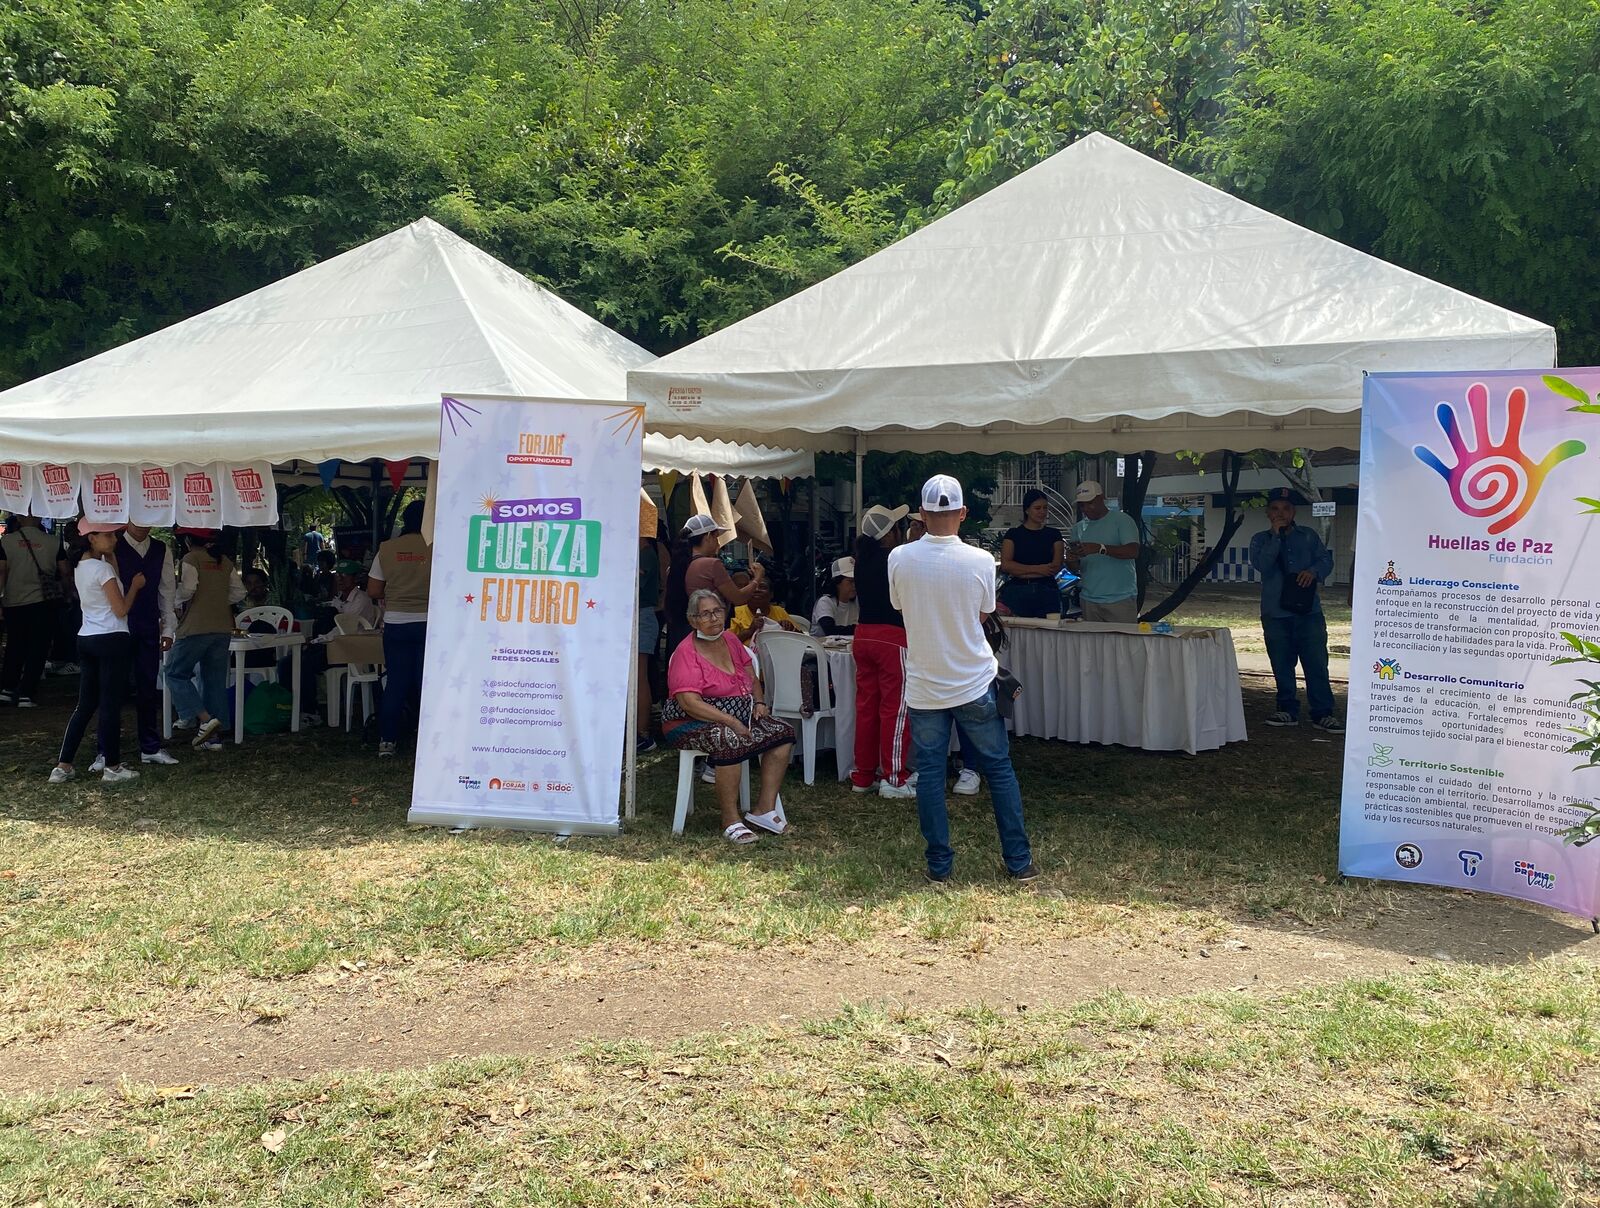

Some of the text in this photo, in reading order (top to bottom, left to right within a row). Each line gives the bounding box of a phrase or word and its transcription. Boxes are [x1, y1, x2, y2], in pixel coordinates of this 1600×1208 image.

[519, 433, 564, 454] FORJAR
[509, 456, 571, 465] OPORTUNIDADES
[44, 469, 68, 483] FUERZA
[144, 475, 168, 488] FUERZA
[50, 484, 70, 496] FUTURO
[96, 480, 120, 493] FUERZA
[186, 480, 210, 492] FUERZA
[98, 495, 120, 506] FUTURO
[147, 490, 169, 501] FUTURO
[188, 495, 210, 506] FUTURO
[499, 502, 574, 518] SOMOS
[478, 521, 587, 573] FUERZA
[1429, 535, 1553, 554] Huellas de Paz
[1489, 553, 1553, 565] Fundación
[1410, 577, 1520, 591] Liderazgo Consciente
[481, 578, 581, 625] FUTURO
[1376, 587, 1437, 598] Acompañamos
[1442, 592, 1481, 601] procesos
[1486, 594, 1496, 602] de
[1501, 595, 1545, 605] desarrollo
[1551, 600, 1590, 608] personal
[1376, 598, 1409, 607] enfoque
[1434, 602, 1498, 613] reconstrucción
[1501, 606, 1514, 614] del
[1517, 608, 1557, 617] proyecto
[1560, 610, 1571, 618] de
[1574, 611, 1593, 620] vida
[1375, 609, 1439, 620] fortalecimiento
[1470, 615, 1477, 623] la
[1488, 617, 1539, 627] mentalidad,
[1551, 621, 1600, 631] promovien
[1375, 620, 1412, 628] procesos
[1427, 623, 1492, 634] transformación
[1494, 628, 1510, 636] con
[1374, 631, 1378, 639] y
[1380, 630, 1388, 638] el
[1389, 631, 1430, 641] desarrollo
[1433, 634, 1443, 642] de
[1445, 634, 1492, 646] habilidades
[1495, 639, 1515, 648] para
[1516, 640, 1524, 648] la
[1526, 641, 1547, 650] vida.
[1373, 640, 1380, 648] la
[1383, 642, 1440, 652] reconciliación
[1450, 646, 1461, 654] las
[1464, 648, 1505, 657] segundas
[520, 656, 560, 664] SOCIALES
[490, 680, 557, 690] @sidocfundacion
[1404, 672, 1525, 690] Desarrollo Comunitario
[489, 690, 563, 701] @vallecompromiso
[1371, 682, 1421, 693] Impulsamos
[1440, 688, 1490, 700] crecimiento
[1497, 693, 1508, 701] de
[1514, 695, 1527, 703] las
[489, 706, 556, 716] @fundacionsidoc
[1371, 694, 1396, 702] través
[1403, 695, 1413, 703] de
[1435, 699, 1481, 710] educación,
[1503, 706, 1576, 720] emprendimiento
[1584, 715, 1589, 723] y
[488, 717, 562, 728] @vallecompromiso
[1370, 704, 1424, 715] participación
[1432, 709, 1460, 718] activa.
[1468, 712, 1528, 726] Fortalecemos
[1536, 720, 1561, 730] redes
[1369, 715, 1577, 744] promovemos oportunidades económicas
[1369, 726, 1420, 736] construimos
[1422, 730, 1446, 739] tejido
[1448, 732, 1472, 742] social
[1475, 736, 1494, 744] para
[1507, 739, 1548, 751] bienestar
[472, 745, 566, 758] www.fundacionsidoc.org
[1399, 759, 1504, 778] Territorio Sostenible
[547, 783, 572, 792] Sidoc
[1366, 770, 1420, 782] Fomentamos
[1439, 778, 1472, 788] cuidado
[1478, 782, 1491, 791] del
[1498, 786, 1532, 796] entorno
[1549, 792, 1557, 800] la
[1366, 782, 1416, 792] responsable
[1419, 786, 1434, 794] con
[1448, 789, 1488, 801] territorio.
[1492, 795, 1555, 811] Desarrollamos
[1379, 793, 1421, 803] educación
[1473, 804, 1530, 818] recuperación
[1535, 812, 1545, 821] de
[1364, 813, 1485, 834] vida y los recursos naturales.
[1365, 803, 1403, 812] prácticas
[1405, 807, 1453, 818] sostenibles
[1456, 813, 1471, 821] que
[1473, 814, 1522, 829] promueven
[1514, 860, 1535, 870] COM
[1514, 868, 1556, 882] PROMISO
[1527, 874, 1554, 890] Valle
